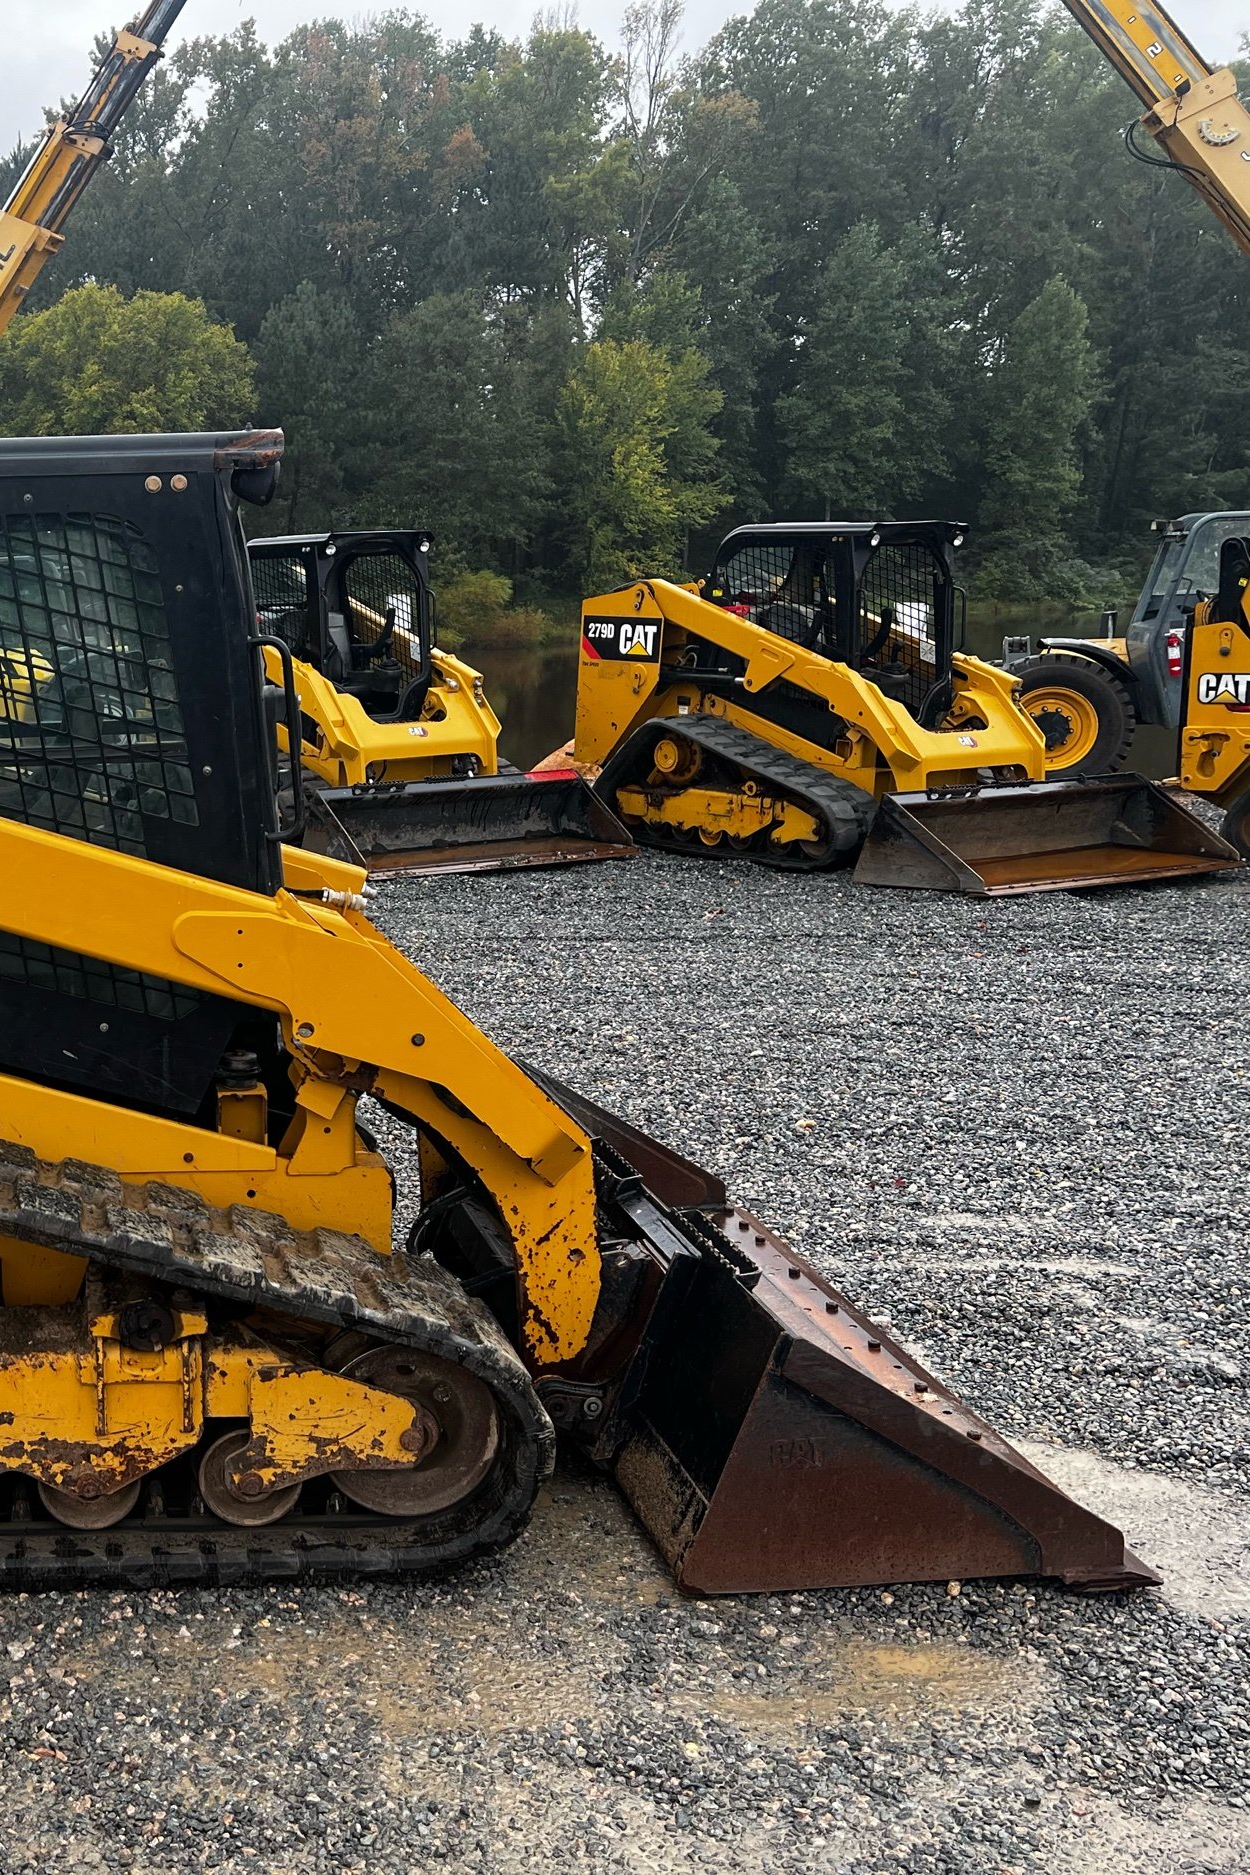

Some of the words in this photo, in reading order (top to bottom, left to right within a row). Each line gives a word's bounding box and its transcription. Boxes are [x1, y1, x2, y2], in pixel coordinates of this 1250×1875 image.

[587, 622, 615, 639] 279D
[619, 623, 658, 656] CAT
[1199, 673, 1250, 704] CAT
[408, 727, 425, 736] CAT
